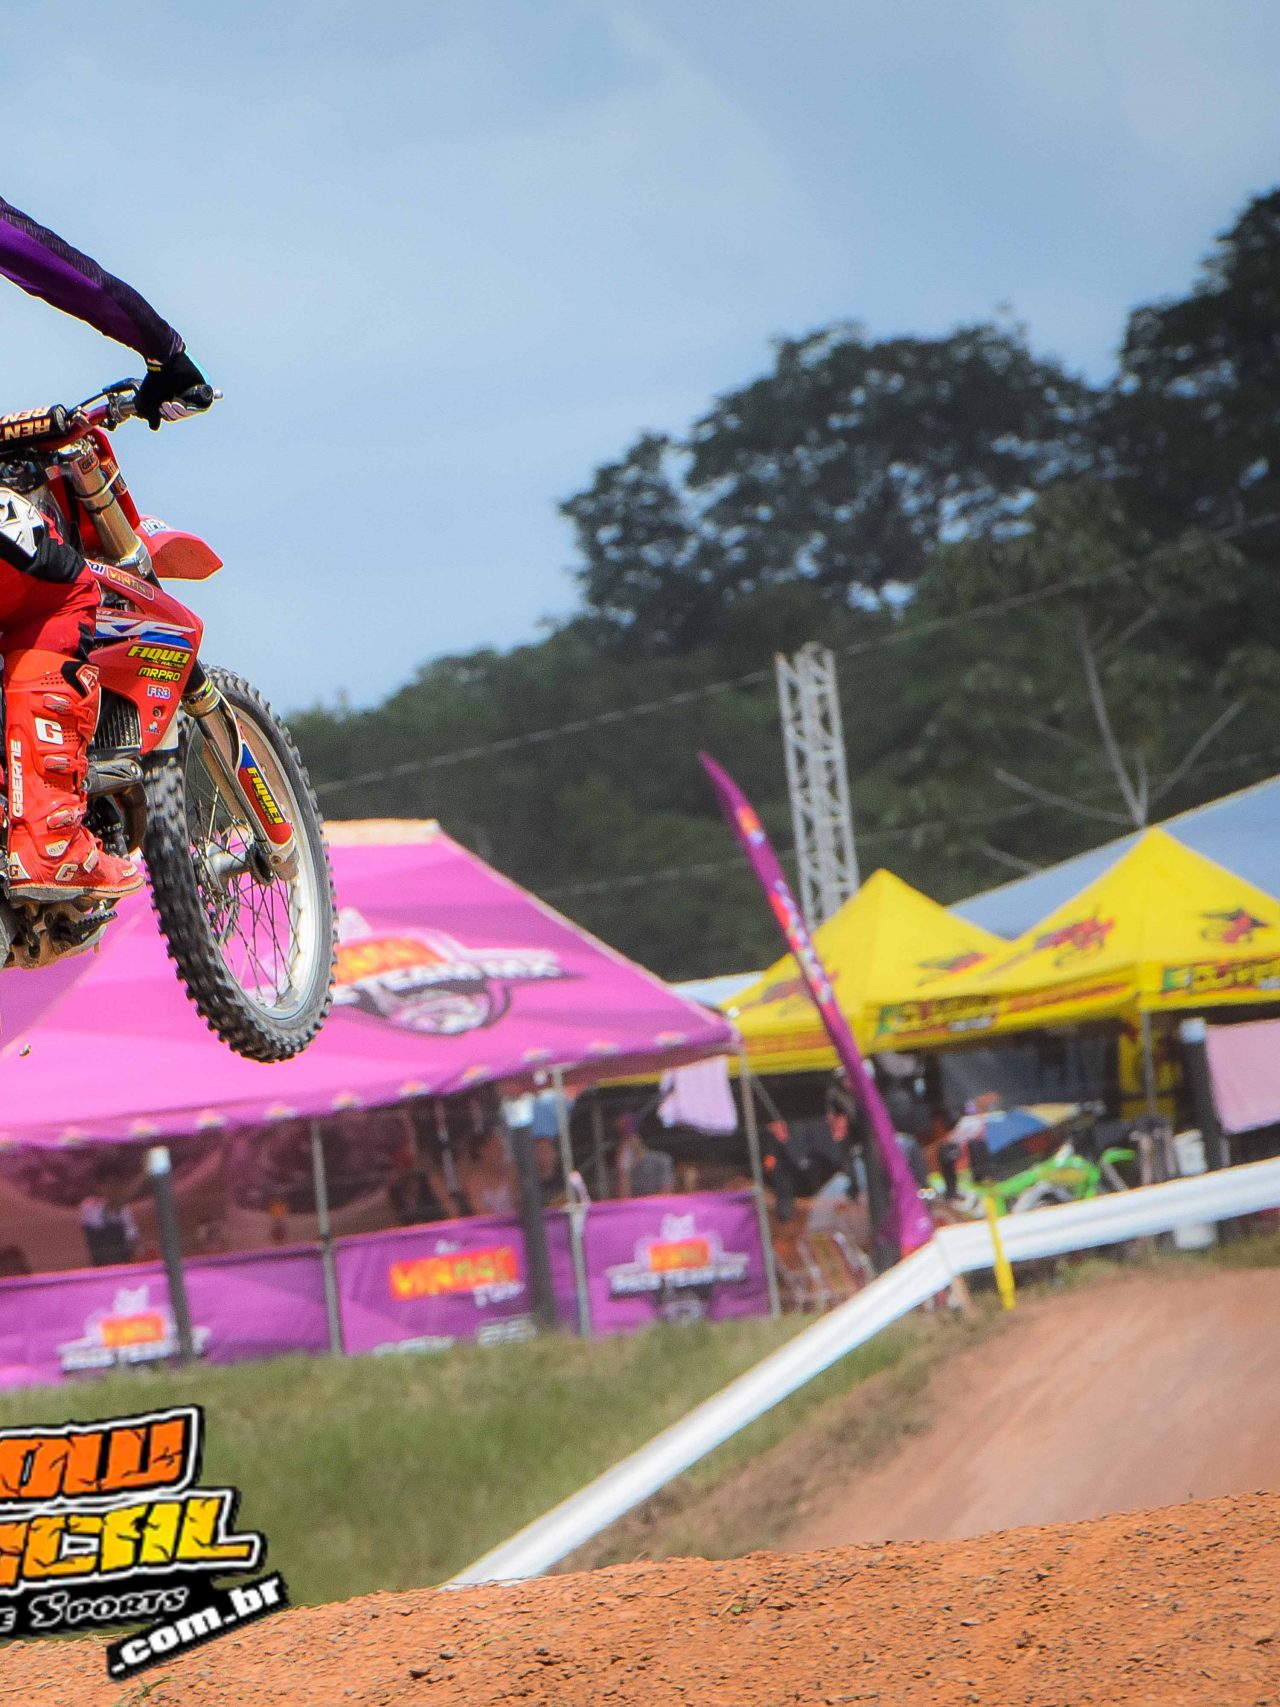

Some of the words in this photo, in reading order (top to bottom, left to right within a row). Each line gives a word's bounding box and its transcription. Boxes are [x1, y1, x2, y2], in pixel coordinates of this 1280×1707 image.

[138, 667, 181, 681] MRPRO
[147, 685, 170, 699] FR3
[34, 717, 64, 745] G
